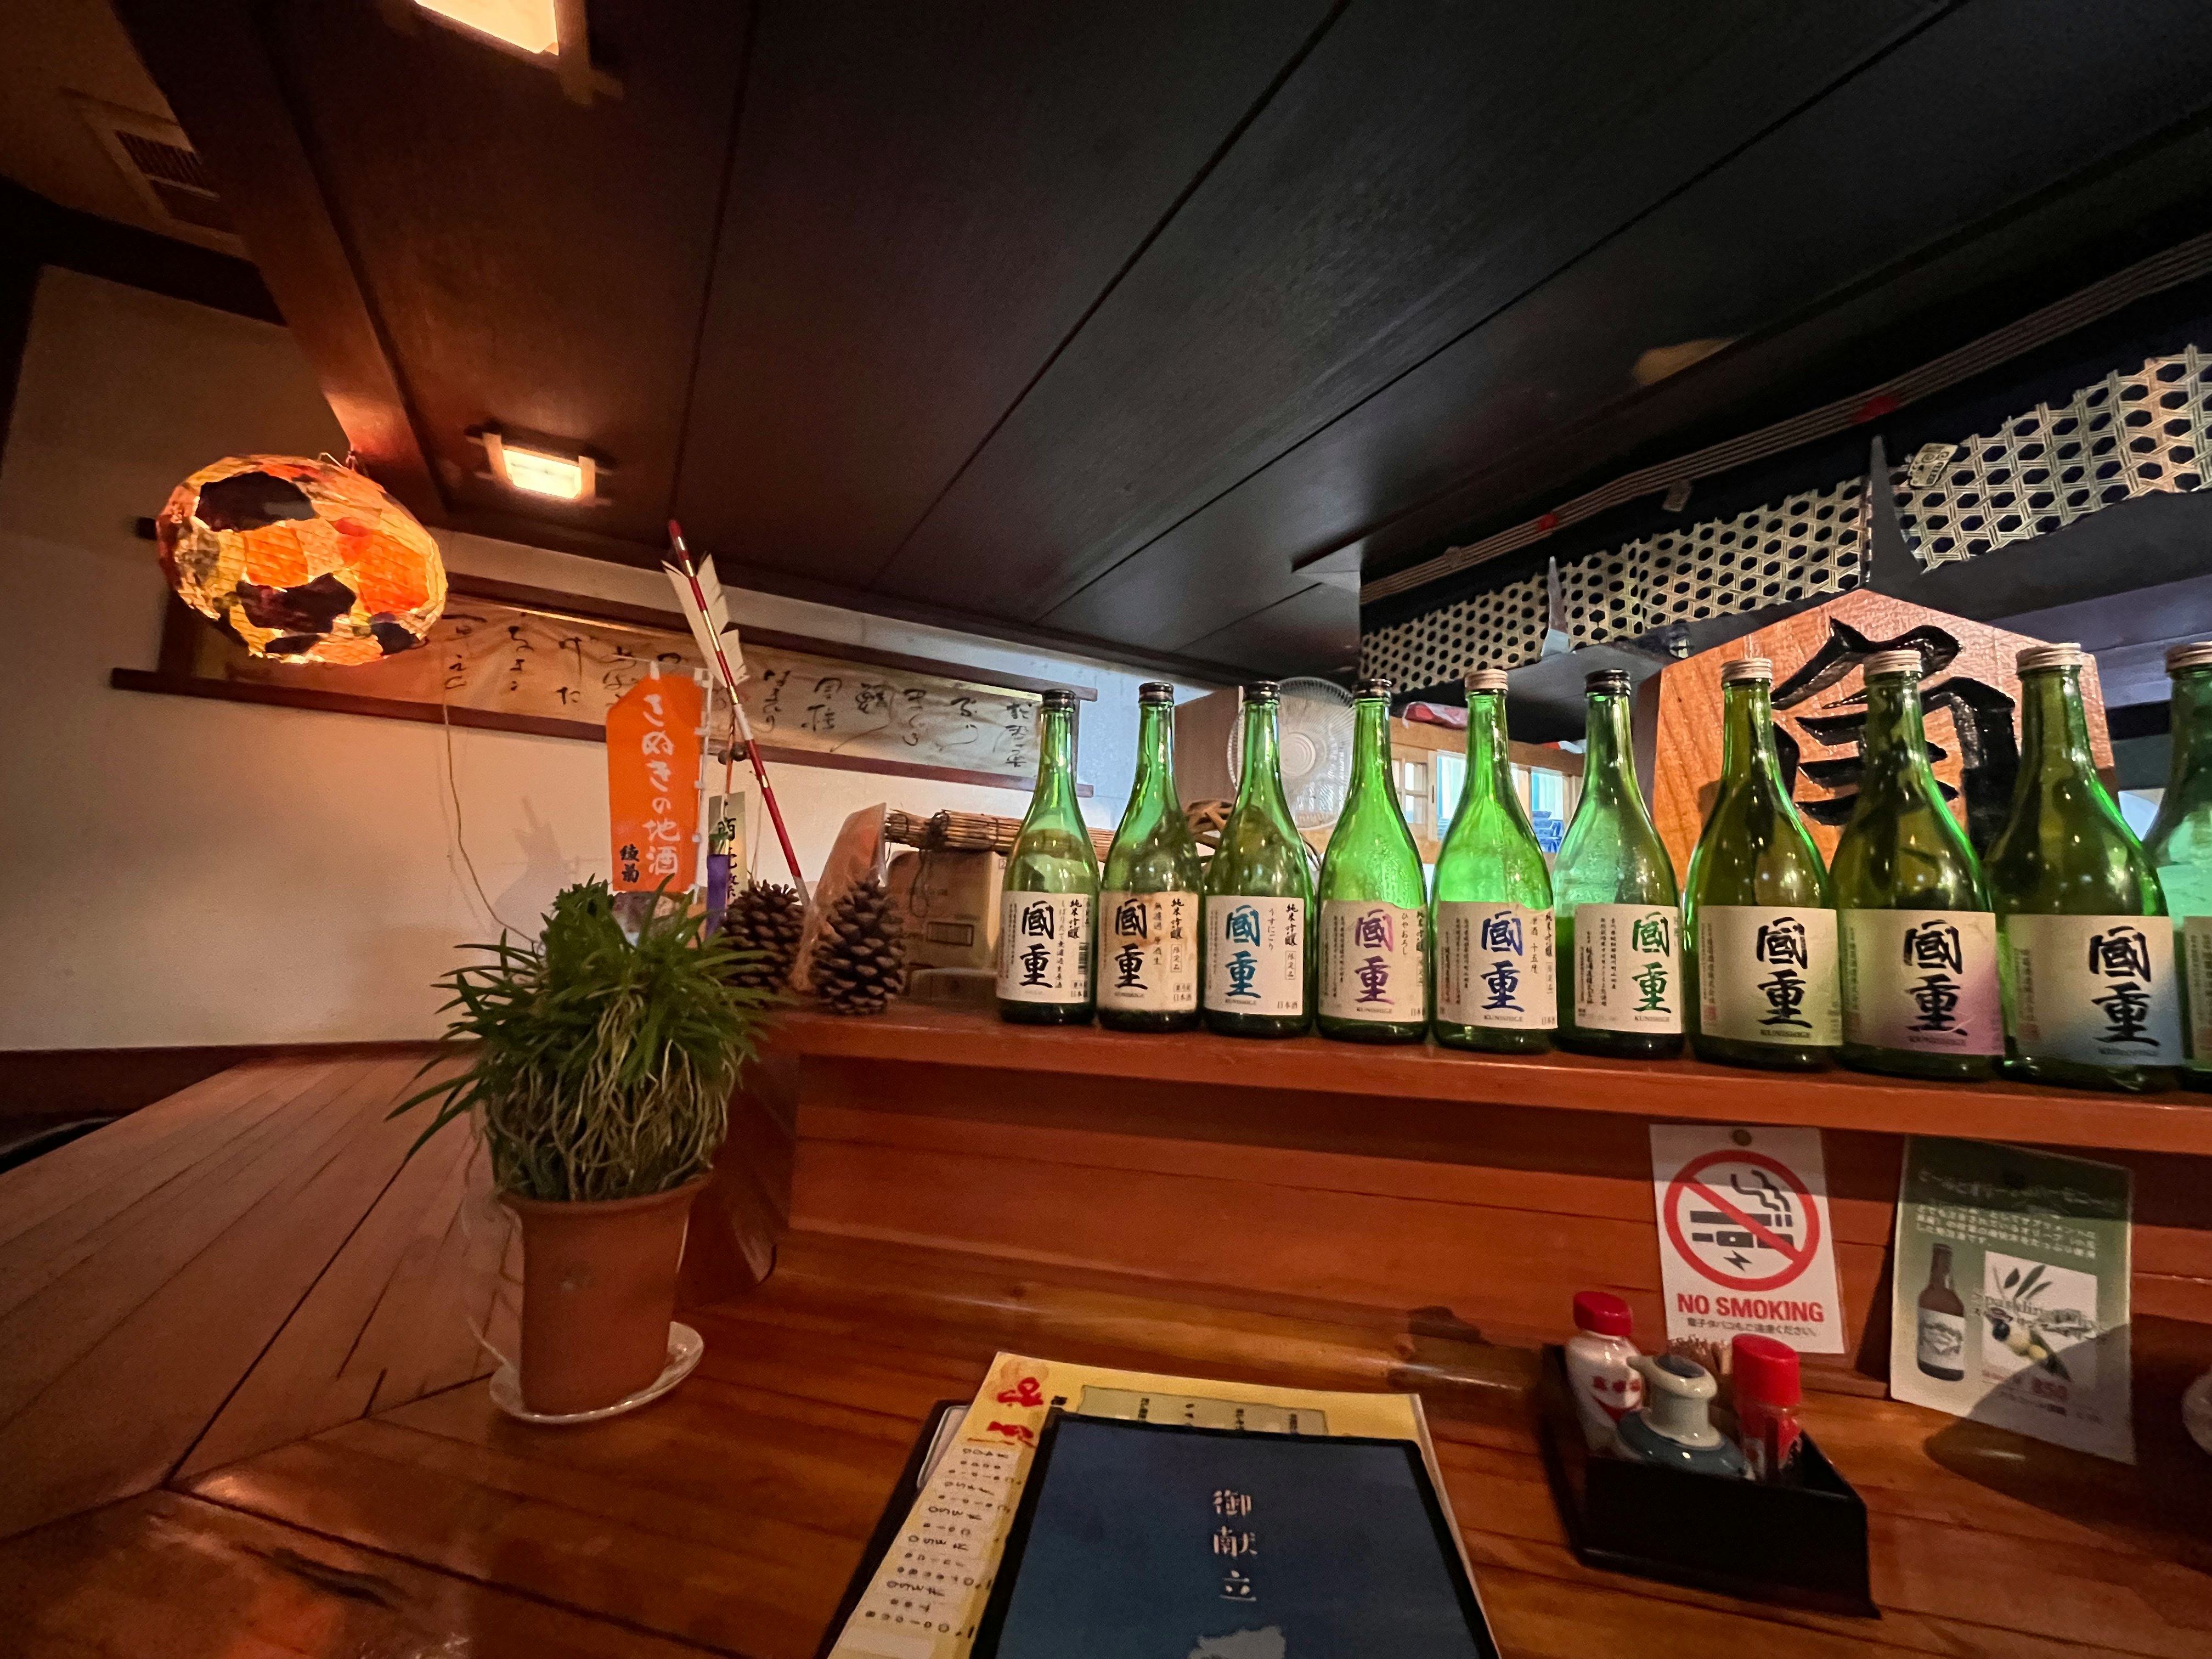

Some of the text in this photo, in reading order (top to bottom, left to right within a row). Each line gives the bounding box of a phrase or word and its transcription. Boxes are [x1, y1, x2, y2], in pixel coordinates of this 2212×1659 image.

[642, 694, 681, 875] さぬきの地酒
[620, 844, 640, 883] 綾菊
[1018, 900, 1054, 988] 國重
[1114, 898, 1148, 990] 國重
[1224, 905, 1261, 998] 國重
[1354, 909, 1395, 1005] 國重
[1480, 910, 1525, 1012] 國重
[1632, 911, 1672, 1014] 國重
[1757, 917, 1813, 1028] 國重
[1903, 919, 1968, 1036] 國重
[2089, 926, 2160, 1047] 國重
[1677, 1293, 1825, 1323] NO SMOKING
[1212, 1489, 1258, 1601] 御献立
